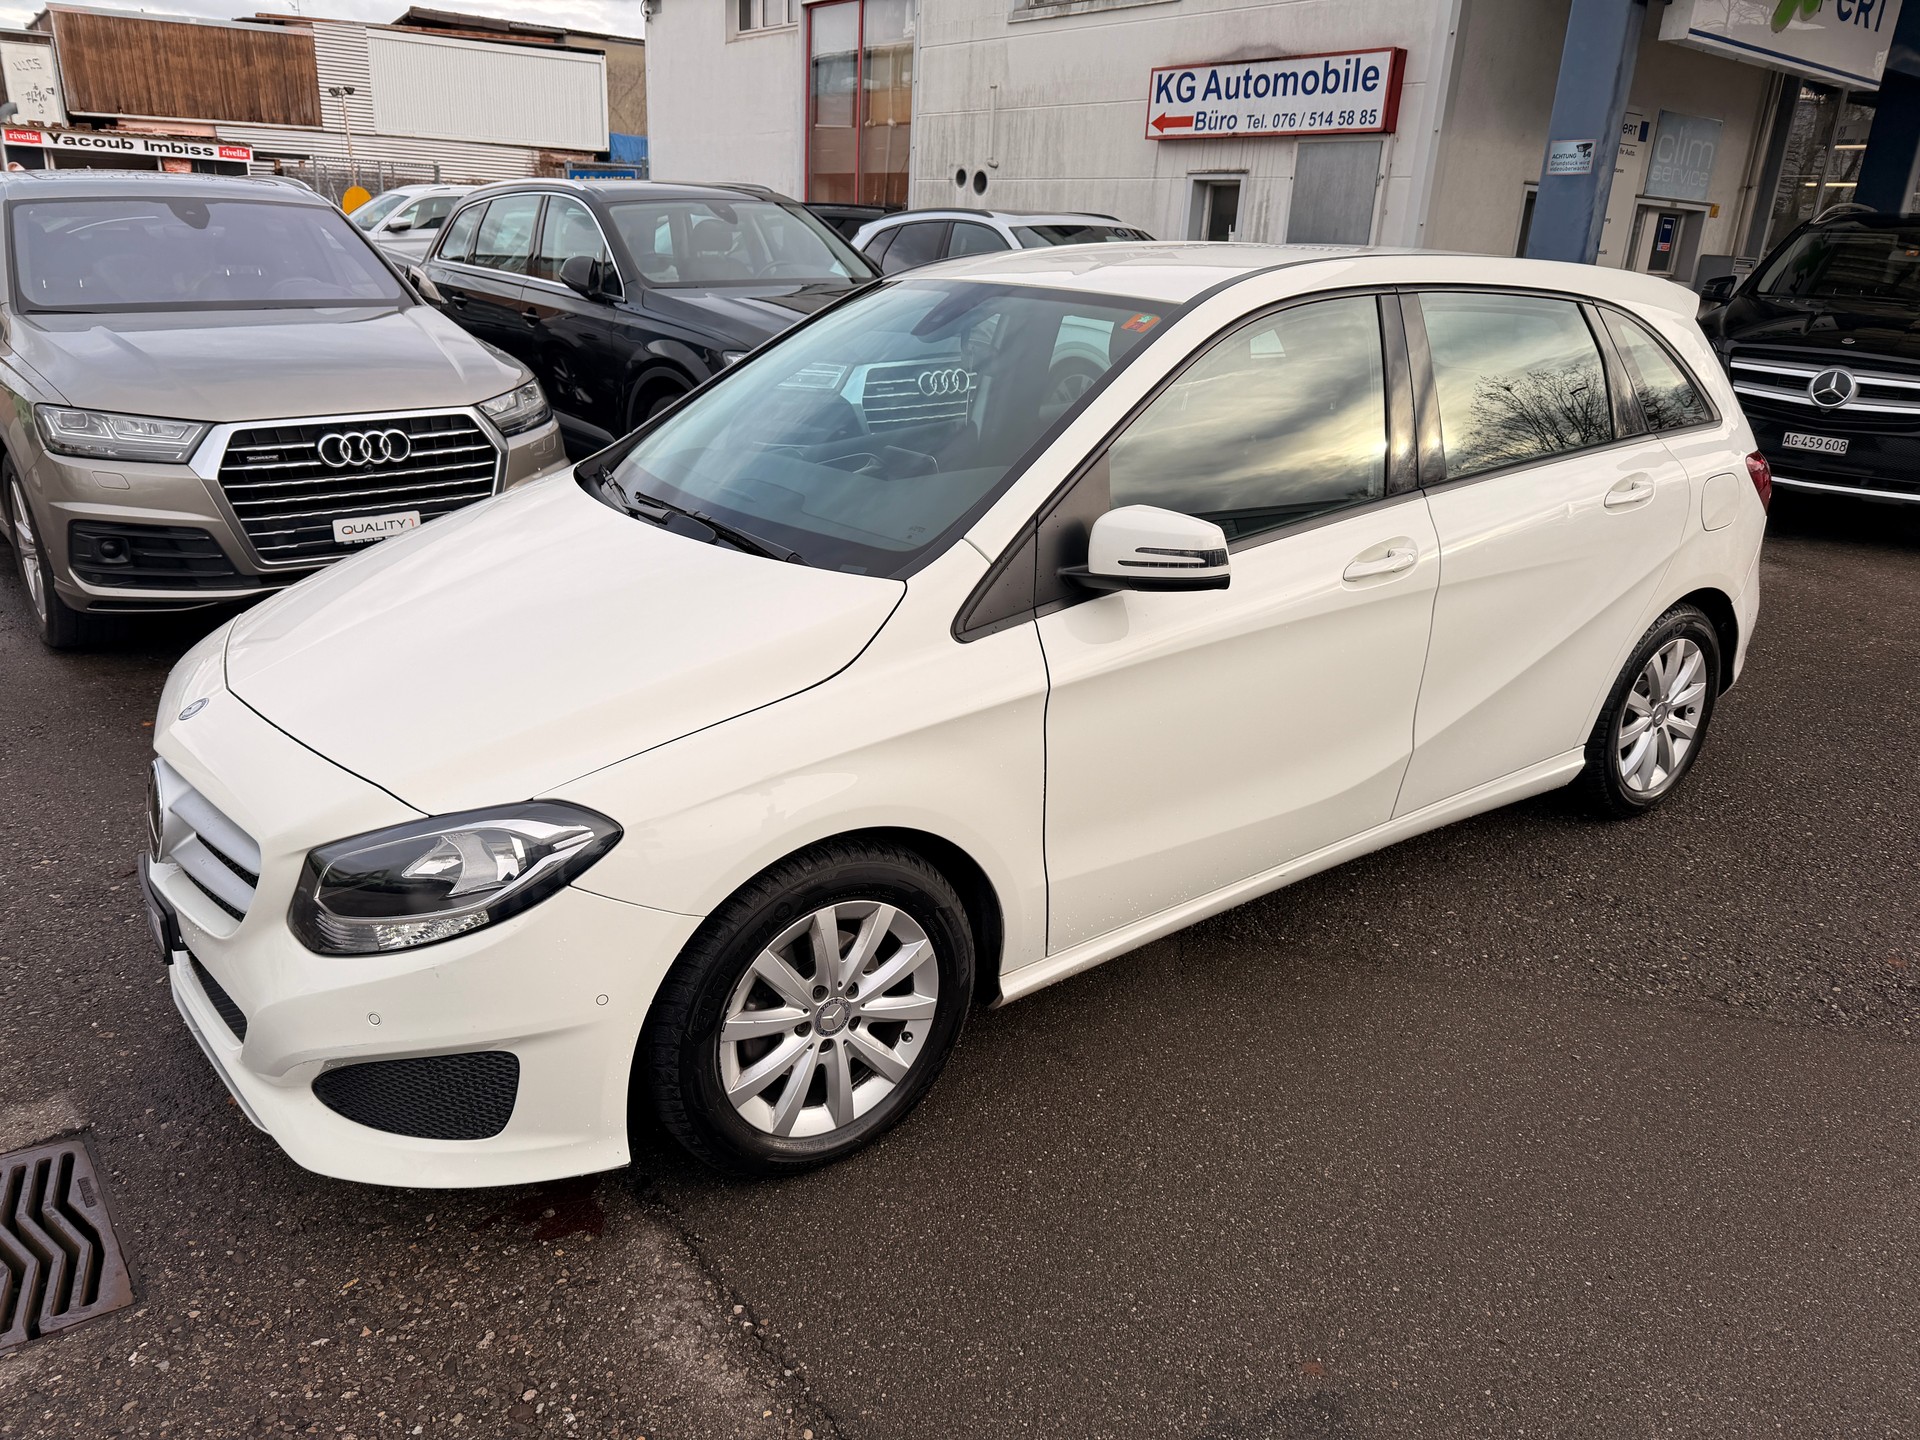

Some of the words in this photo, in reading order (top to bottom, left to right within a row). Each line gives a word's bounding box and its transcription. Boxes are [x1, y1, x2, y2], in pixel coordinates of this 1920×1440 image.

[1155, 71, 1196, 104] KG
[1201, 57, 1380, 101] Automobile
[1194, 110, 1238, 131] Büro
[1246, 113, 1268, 129] Tel.
[1272, 112, 1296, 128] 076
[1308, 110, 1334, 126] 514
[1337, 109, 1355, 125] 58
[1359, 108, 1377, 124] 85
[8, 131, 39, 142] rivella
[47, 132, 134, 150] Yacoub
[143, 140, 215, 157] Imbiss
[1656, 125, 1714, 170] clim
[221, 148, 248, 158] rivella
[1651, 165, 1709, 187] service
[341, 518, 406, 535] QUALITY
